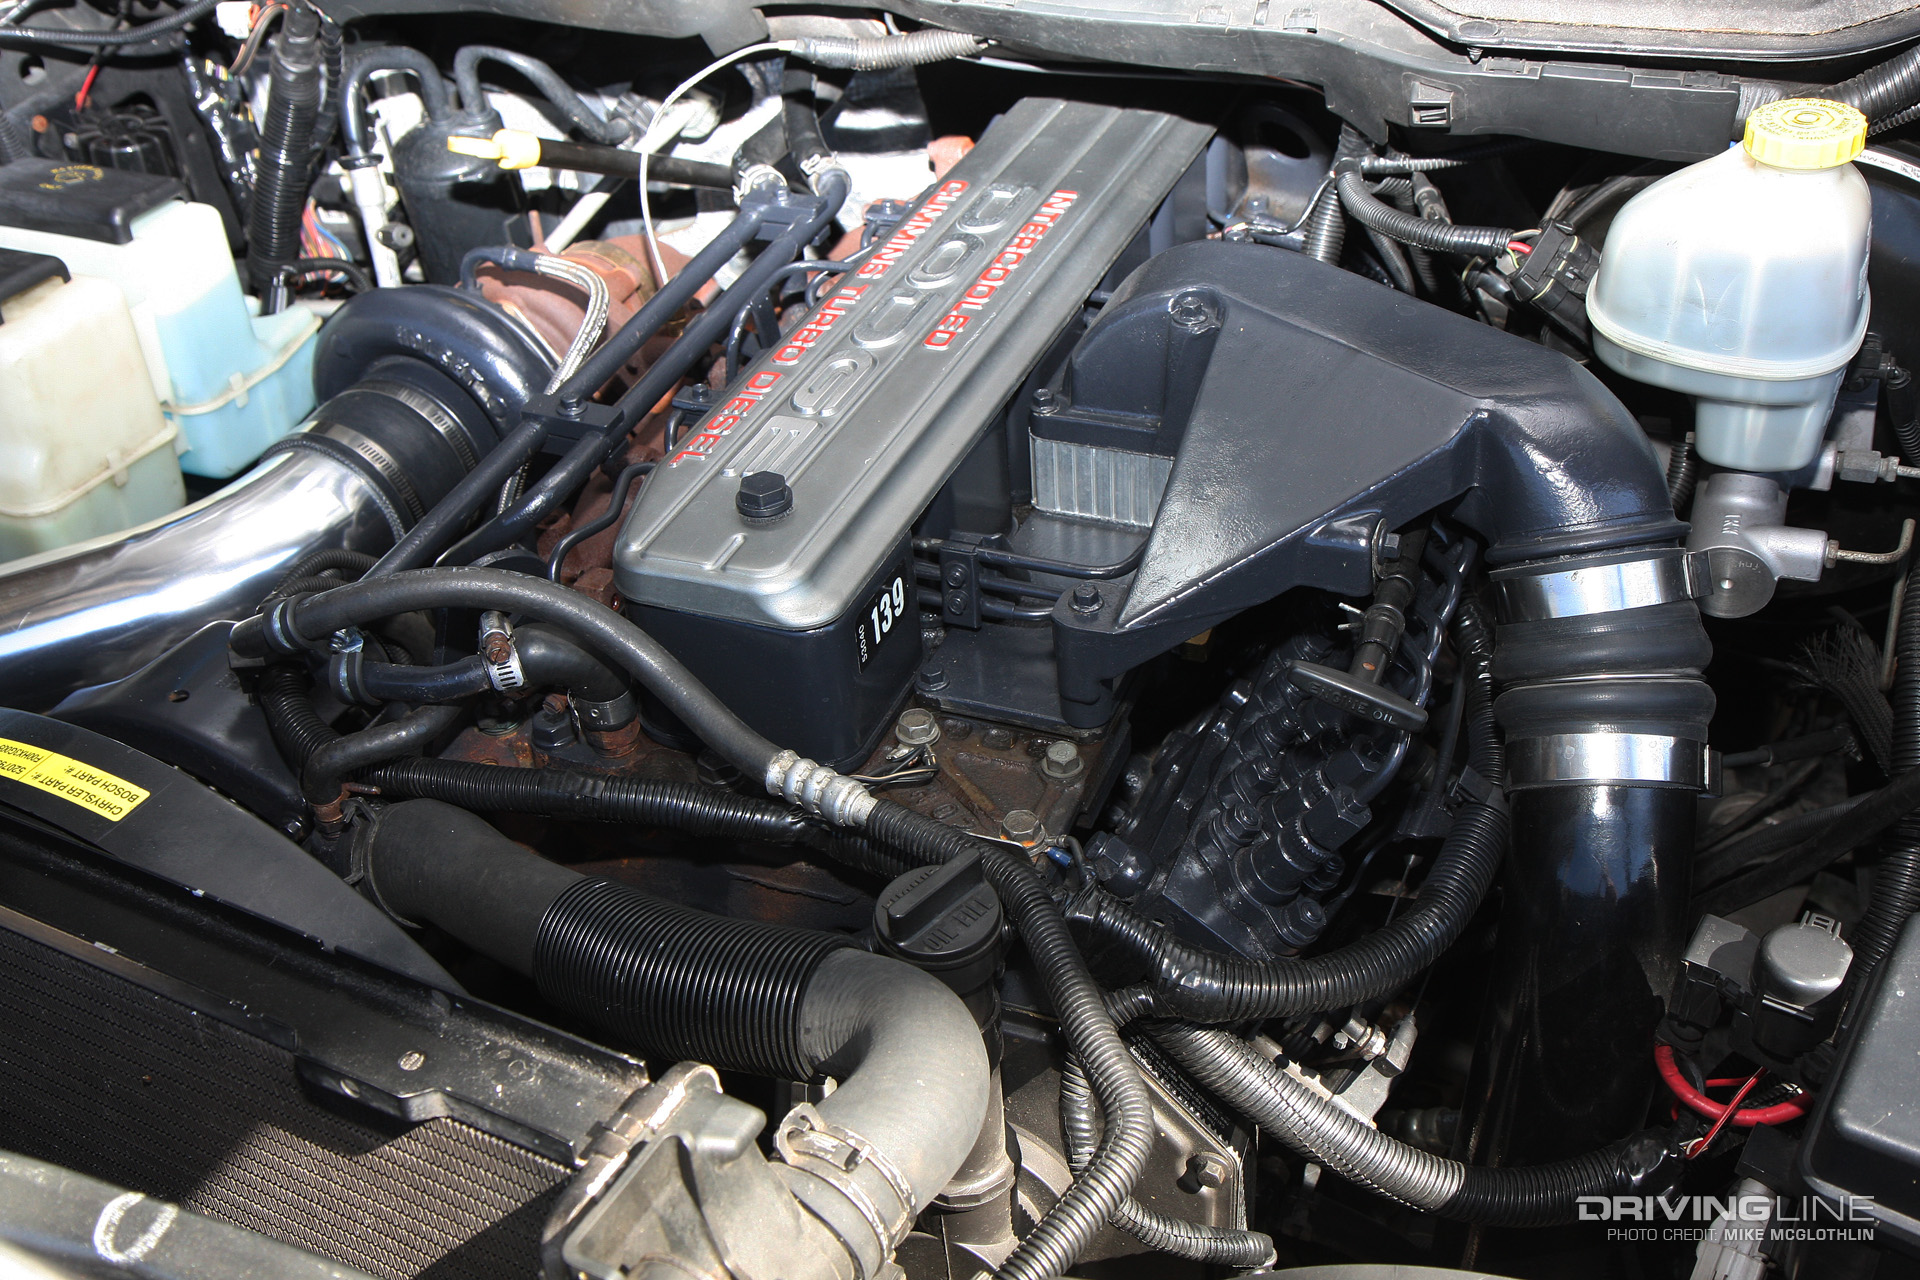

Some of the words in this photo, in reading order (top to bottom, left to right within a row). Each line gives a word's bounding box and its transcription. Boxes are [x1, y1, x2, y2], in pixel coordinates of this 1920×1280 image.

[856, 180, 969, 280] CUMMINS
[921, 189, 1078, 351] INTERCOOLED
[720, 182, 1036, 478] DODGE
[770, 283, 863, 367] TURBO
[668, 371, 784, 469] DIESEL
[871, 576, 905, 645] 139
[858, 624, 868, 663] 53040
[1372, 709, 1399, 726] OIL
[39, 776, 69, 792] PART
[67, 786, 123, 816] CHRYSLER
[72, 769, 101, 788] PART
[100, 781, 140, 803] BOSCH
[922, 927, 960, 951] OIL
[953, 898, 995, 928] FILL
